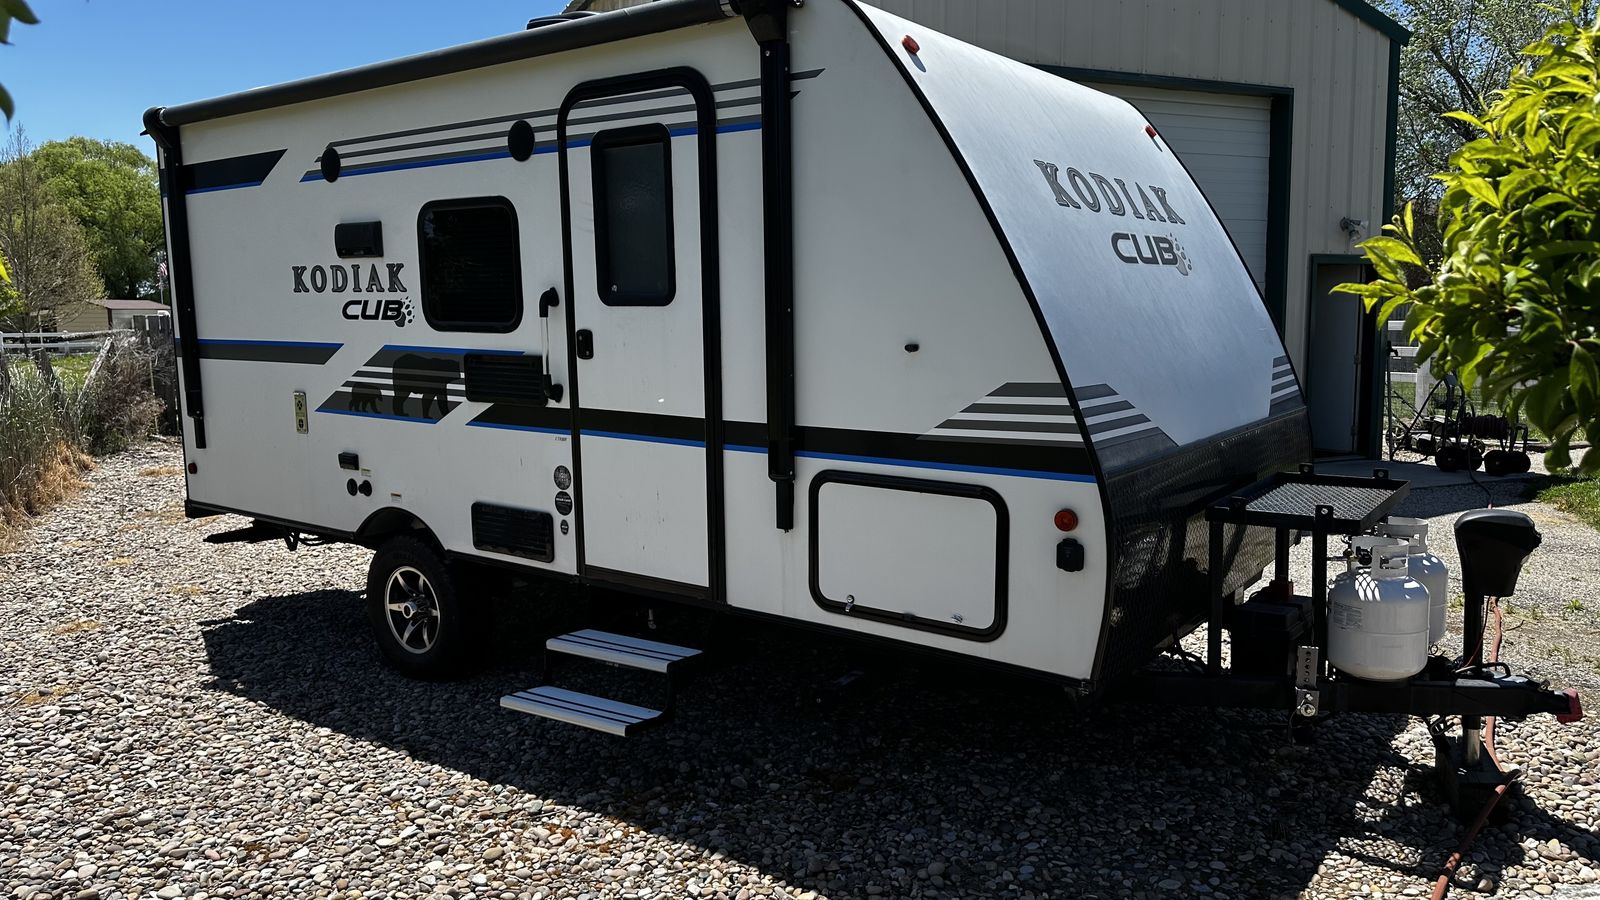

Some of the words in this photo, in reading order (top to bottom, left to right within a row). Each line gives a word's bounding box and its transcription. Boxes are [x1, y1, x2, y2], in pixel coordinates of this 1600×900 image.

[1033, 159, 1186, 225] KODIAK
[1111, 232, 1178, 265] CUB
[291, 262, 407, 293] KODIAK
[342, 299, 403, 320] CUB
